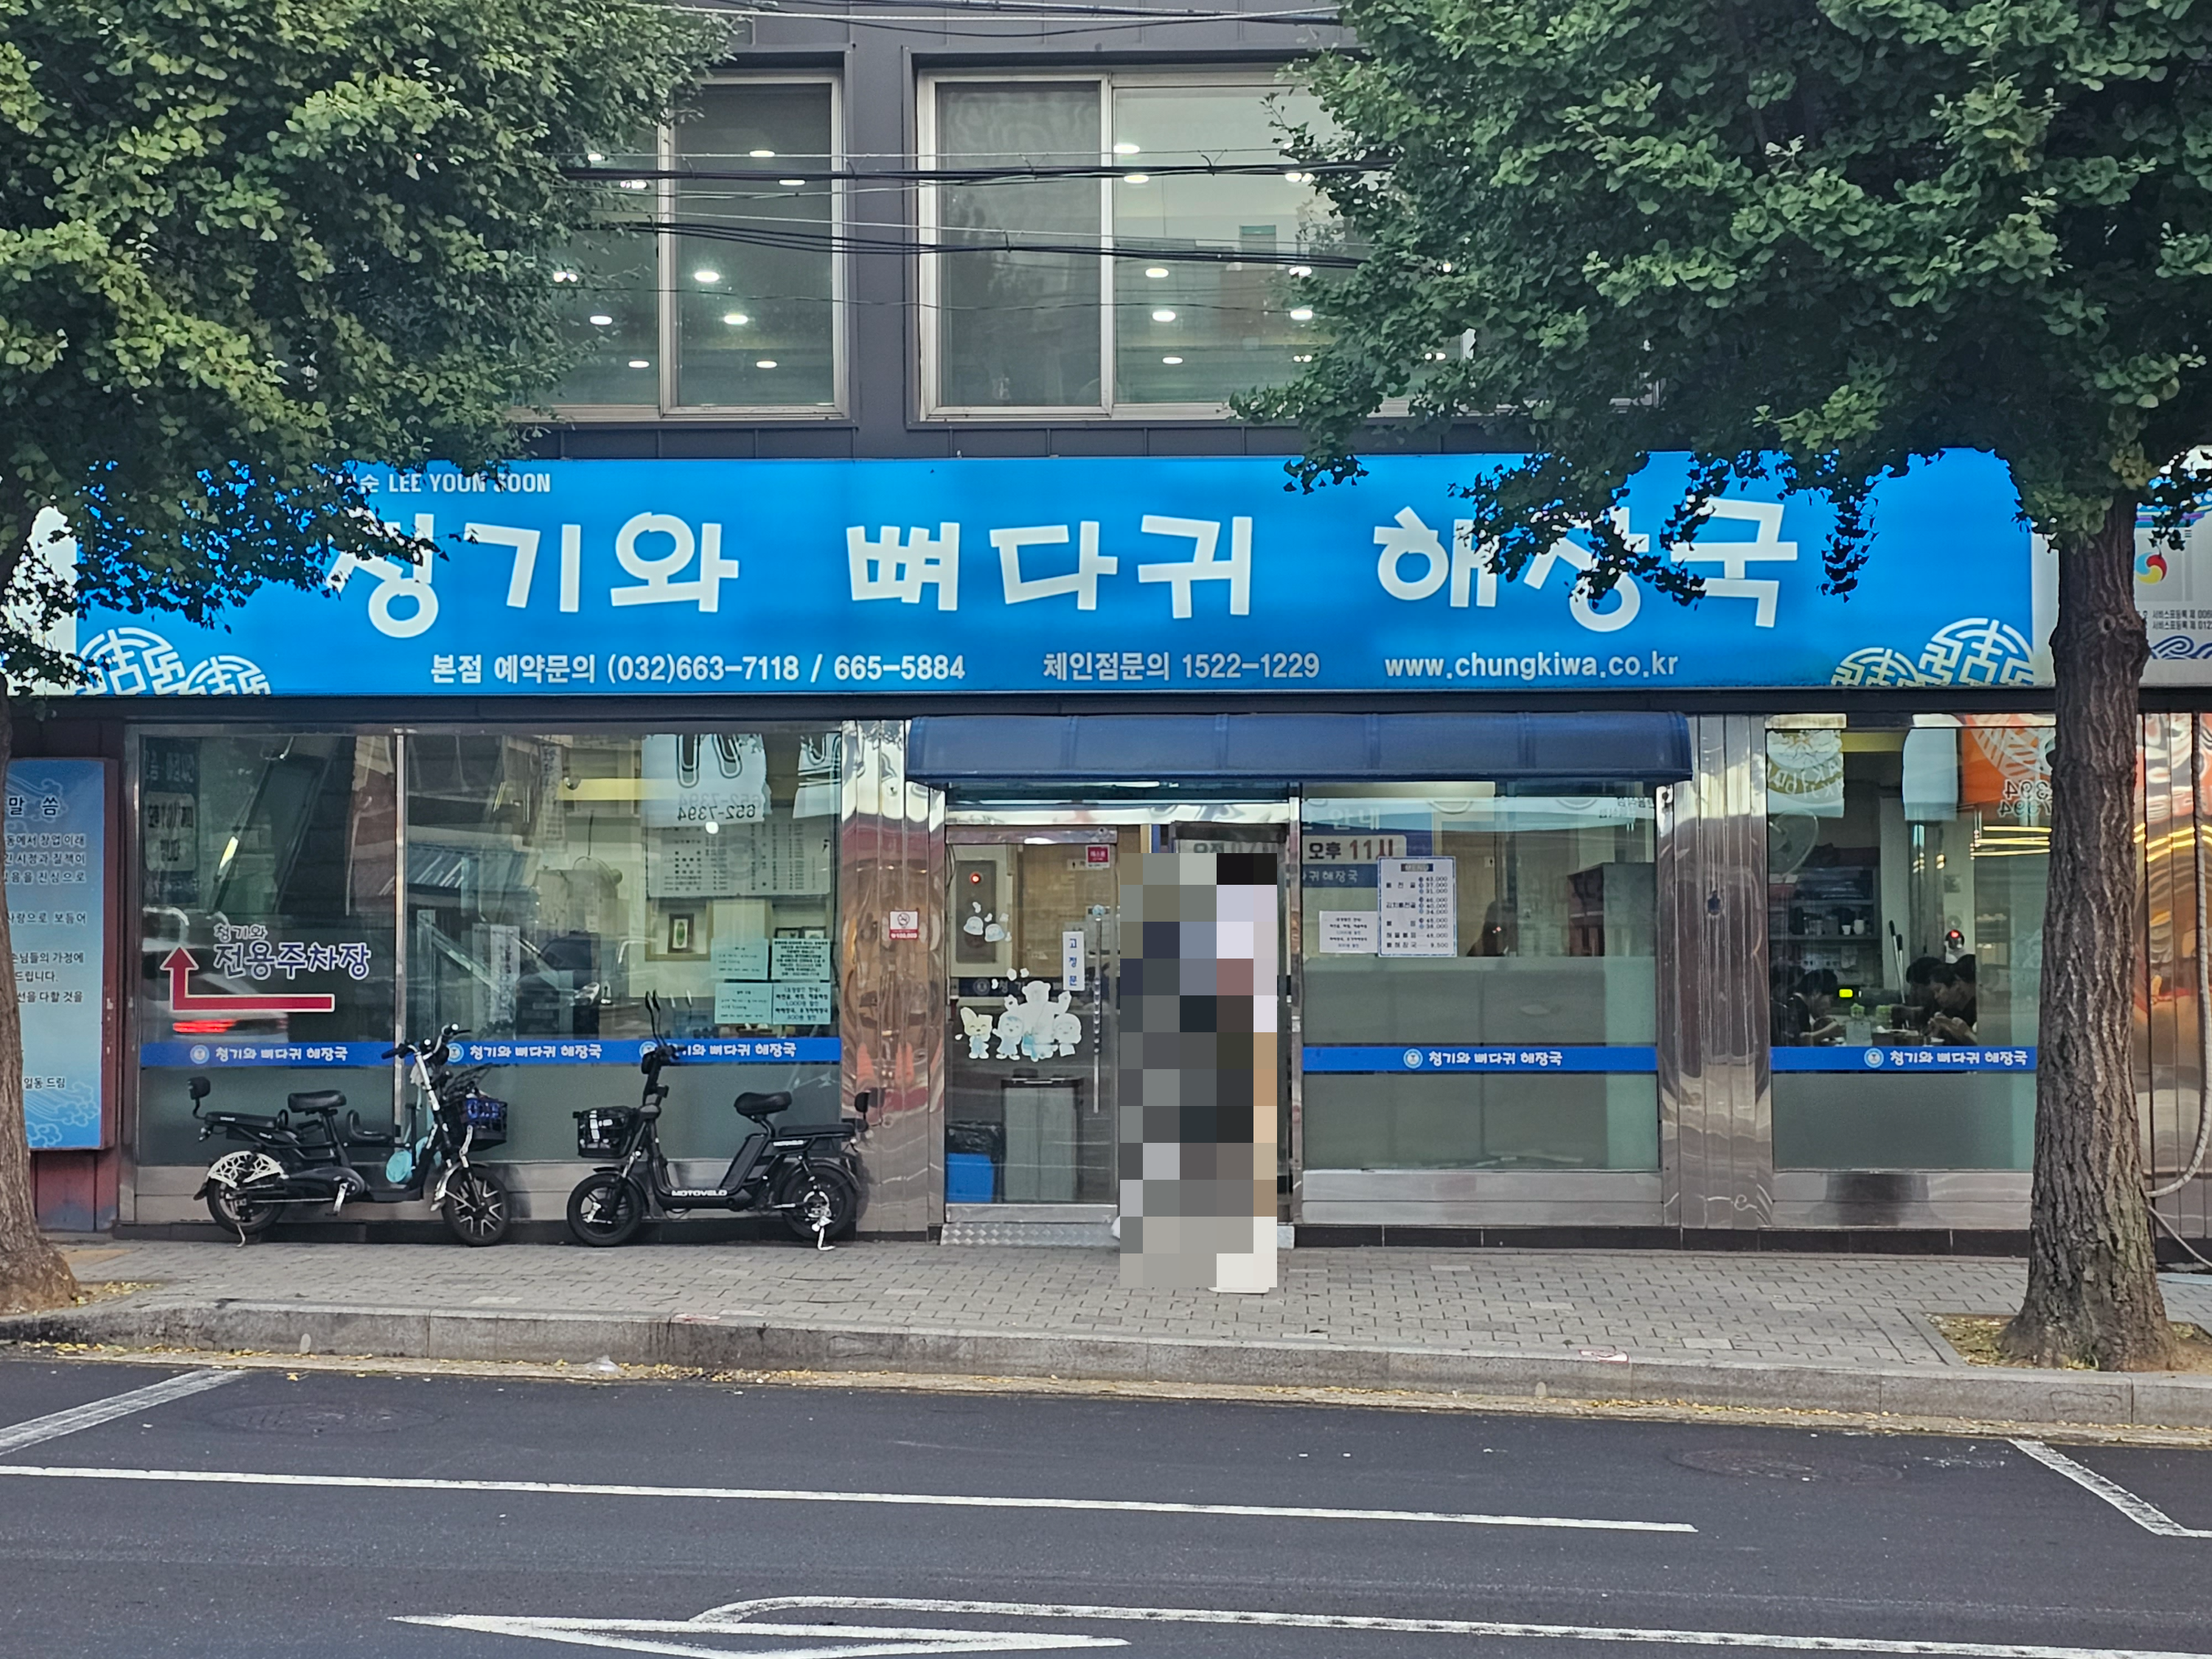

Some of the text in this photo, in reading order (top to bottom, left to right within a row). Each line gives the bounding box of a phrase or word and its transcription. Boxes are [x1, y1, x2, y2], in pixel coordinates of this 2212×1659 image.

[389, 473, 422, 493] LEE
[846, 514, 1253, 619] 뼈다귀
[1373, 497, 1798, 633] 해장국
[431, 653, 482, 684] 본점
[494, 653, 595, 684] 예약문의
[608, 653, 800, 684] (032)663-7118
[834, 654, 966, 681] 665-5884
[1043, 651, 1321, 682] 체인점문의 1522-1229
[1384, 650, 1679, 682] www.chungkiwa.co.kr
[1308, 841, 1342, 860] 오후
[39, 872, 85, 883] 진심으로
[214, 922, 268, 943] 청기와
[53, 952, 84, 964] 가정에
[213, 940, 372, 981] 전용주차장
[63, 991, 83, 1003] 것을
[216, 1048, 257, 1062] 청기와
[307, 1046, 348, 1061] 해장국
[470, 1044, 512, 1060] 청기와
[560, 1043, 602, 1060] 해장국
[755, 1042, 797, 1058] 해장국
[1428, 1051, 1470, 1066] 청기와
[1520, 1050, 1563, 1066] 해장국
[1890, 1050, 1933, 1066] 청기와
[1984, 1050, 2028, 1066] 해장국
[24, 1078, 66, 1089] 일동 드림
